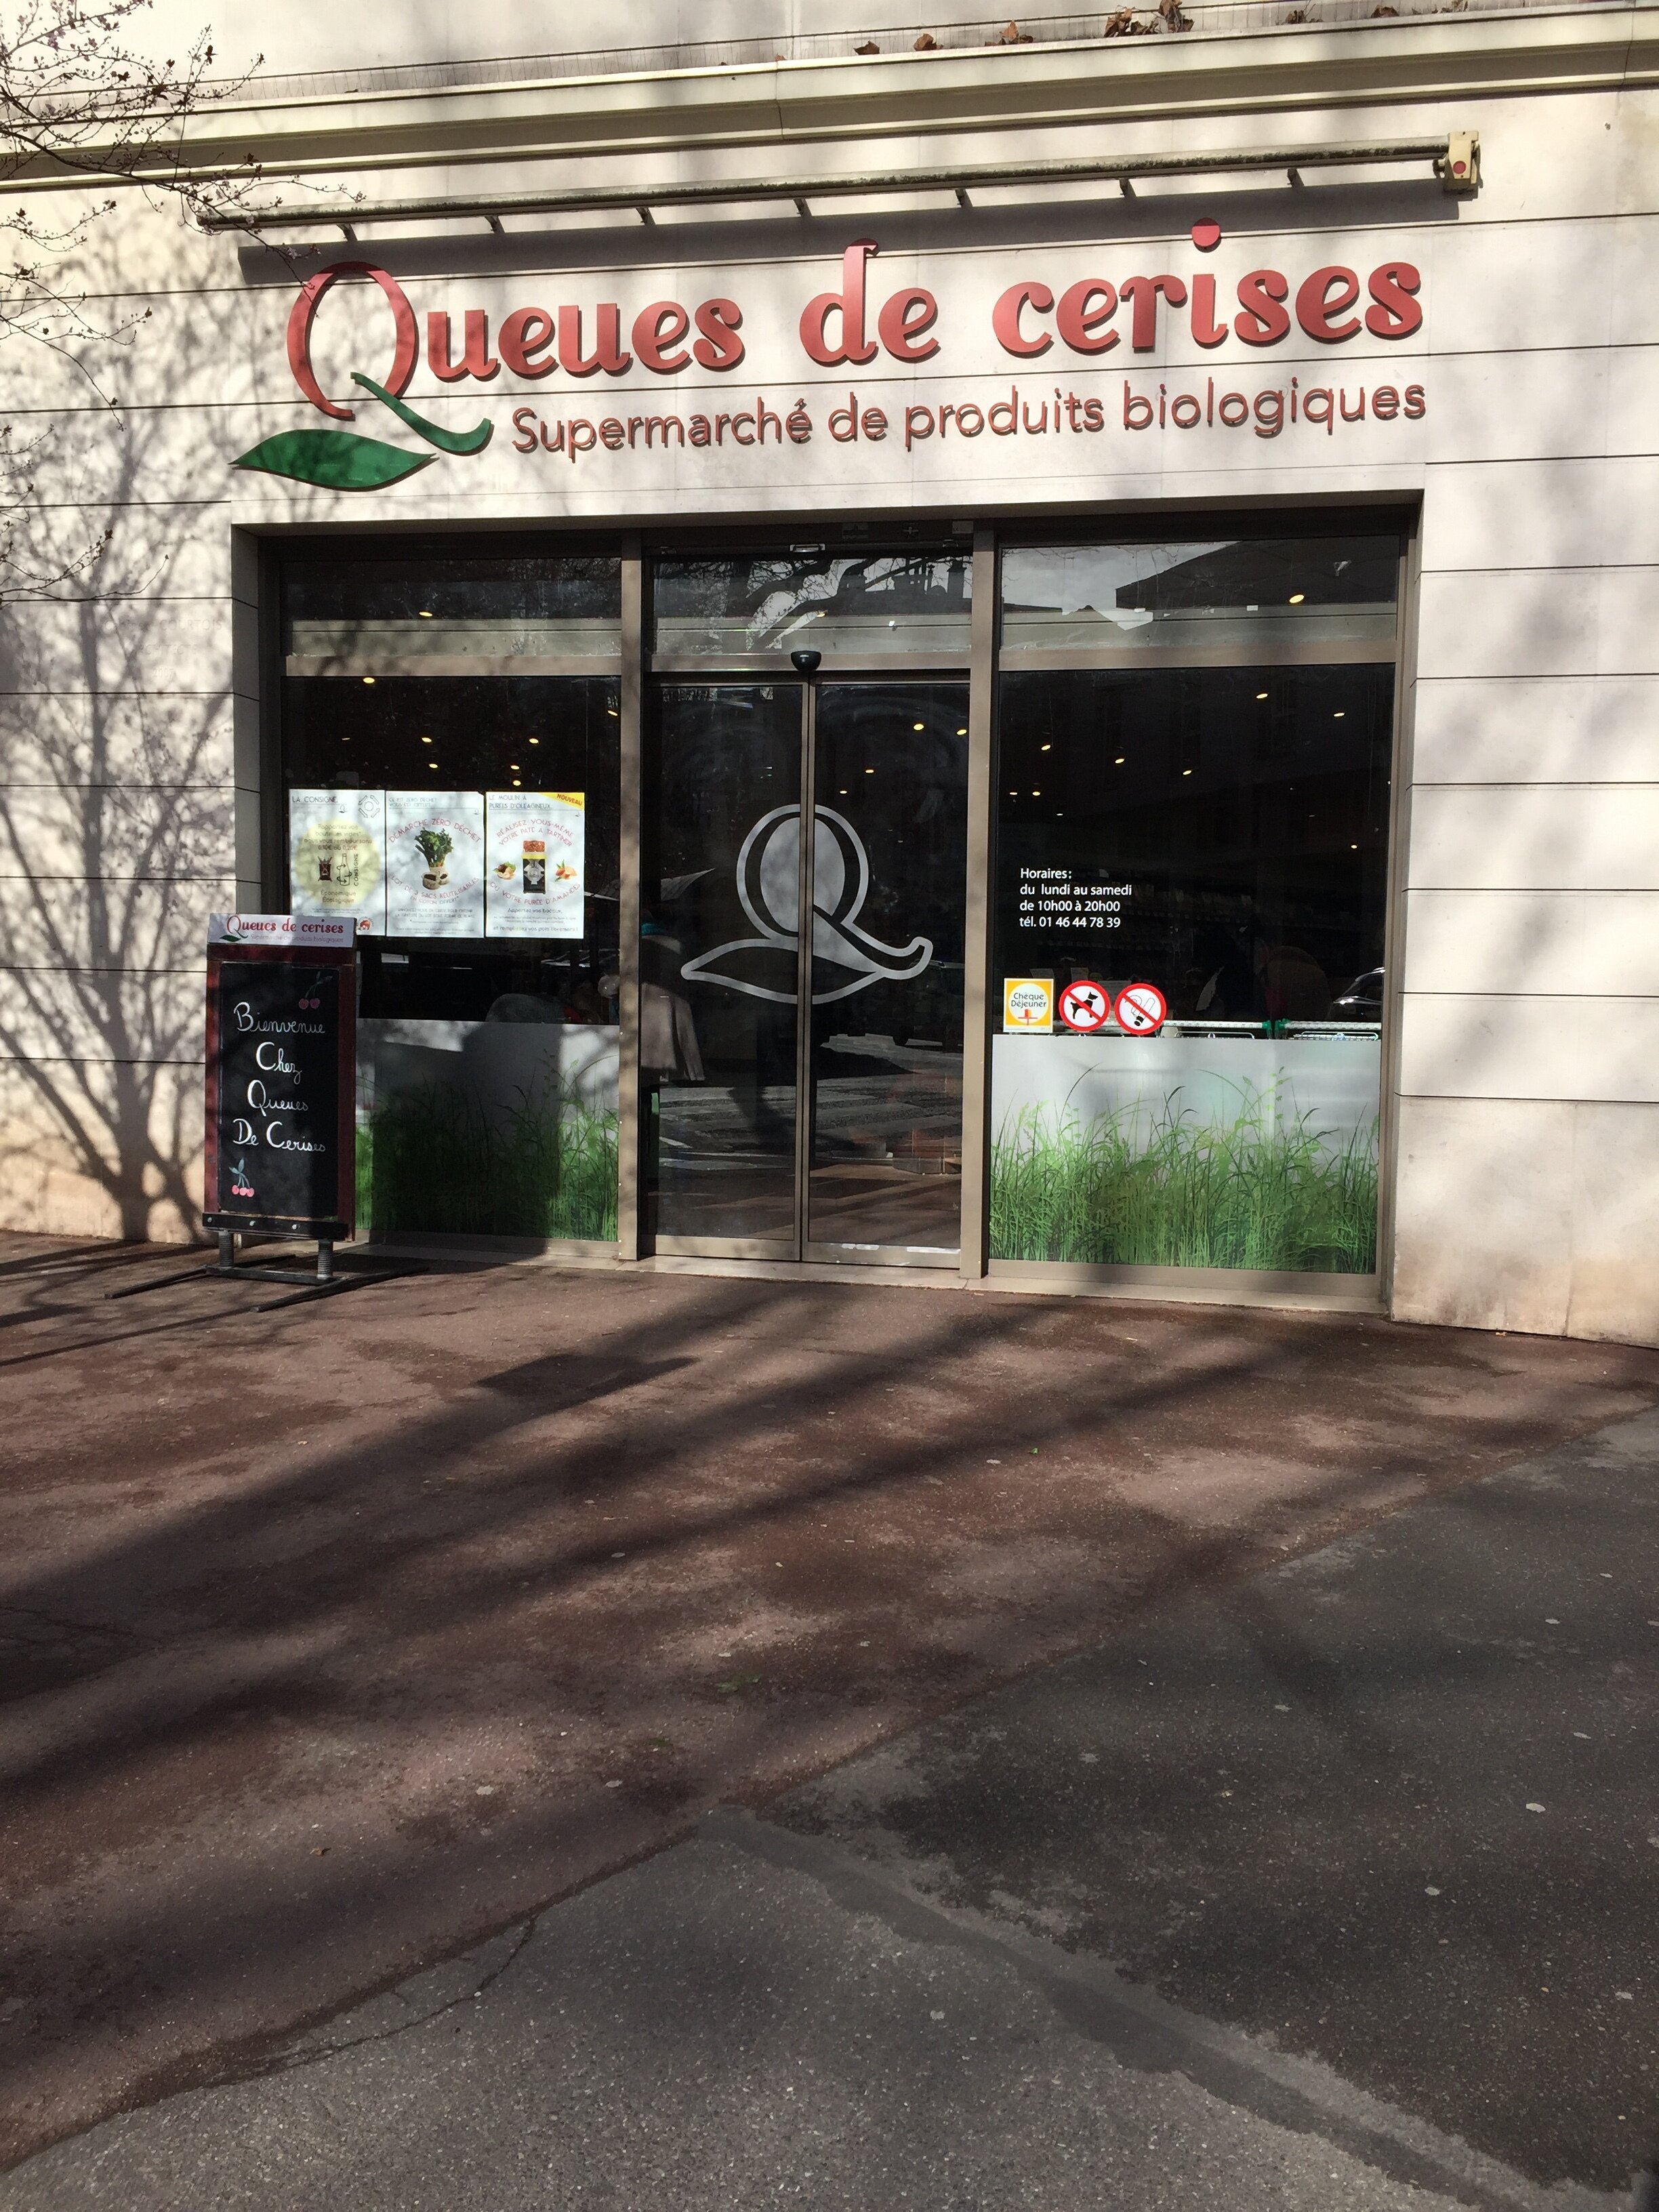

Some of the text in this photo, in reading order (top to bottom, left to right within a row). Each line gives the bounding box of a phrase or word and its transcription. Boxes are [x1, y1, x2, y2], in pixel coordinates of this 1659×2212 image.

[286, 218, 1424, 455] Queues de cerises
[512, 376, 1427, 464] Supermarché de produits biologiques
[556, 794, 583, 806] NOUVEAU
[547, 829, 573, 846] TARTINER
[1020, 883, 1132, 896] du lundi au samedi
[1019, 900, 1120, 912] de 10h00 à 20h00
[226, 915, 276, 939] Queues
[281, 918, 297, 932] de
[301, 918, 344, 934] cerises
[1019, 916, 1121, 927] tél. 01 46 44 78 39
[1010, 999, 1047, 1009] Déjeuner
[1013, 992, 1044, 1001] Chèque
[233, 1002, 326, 1034] Bienvenue
[255, 1041, 303, 1084] Chez
[247, 1080, 309, 1117] Queues
[232, 1118, 326, 1152] De Cerises
